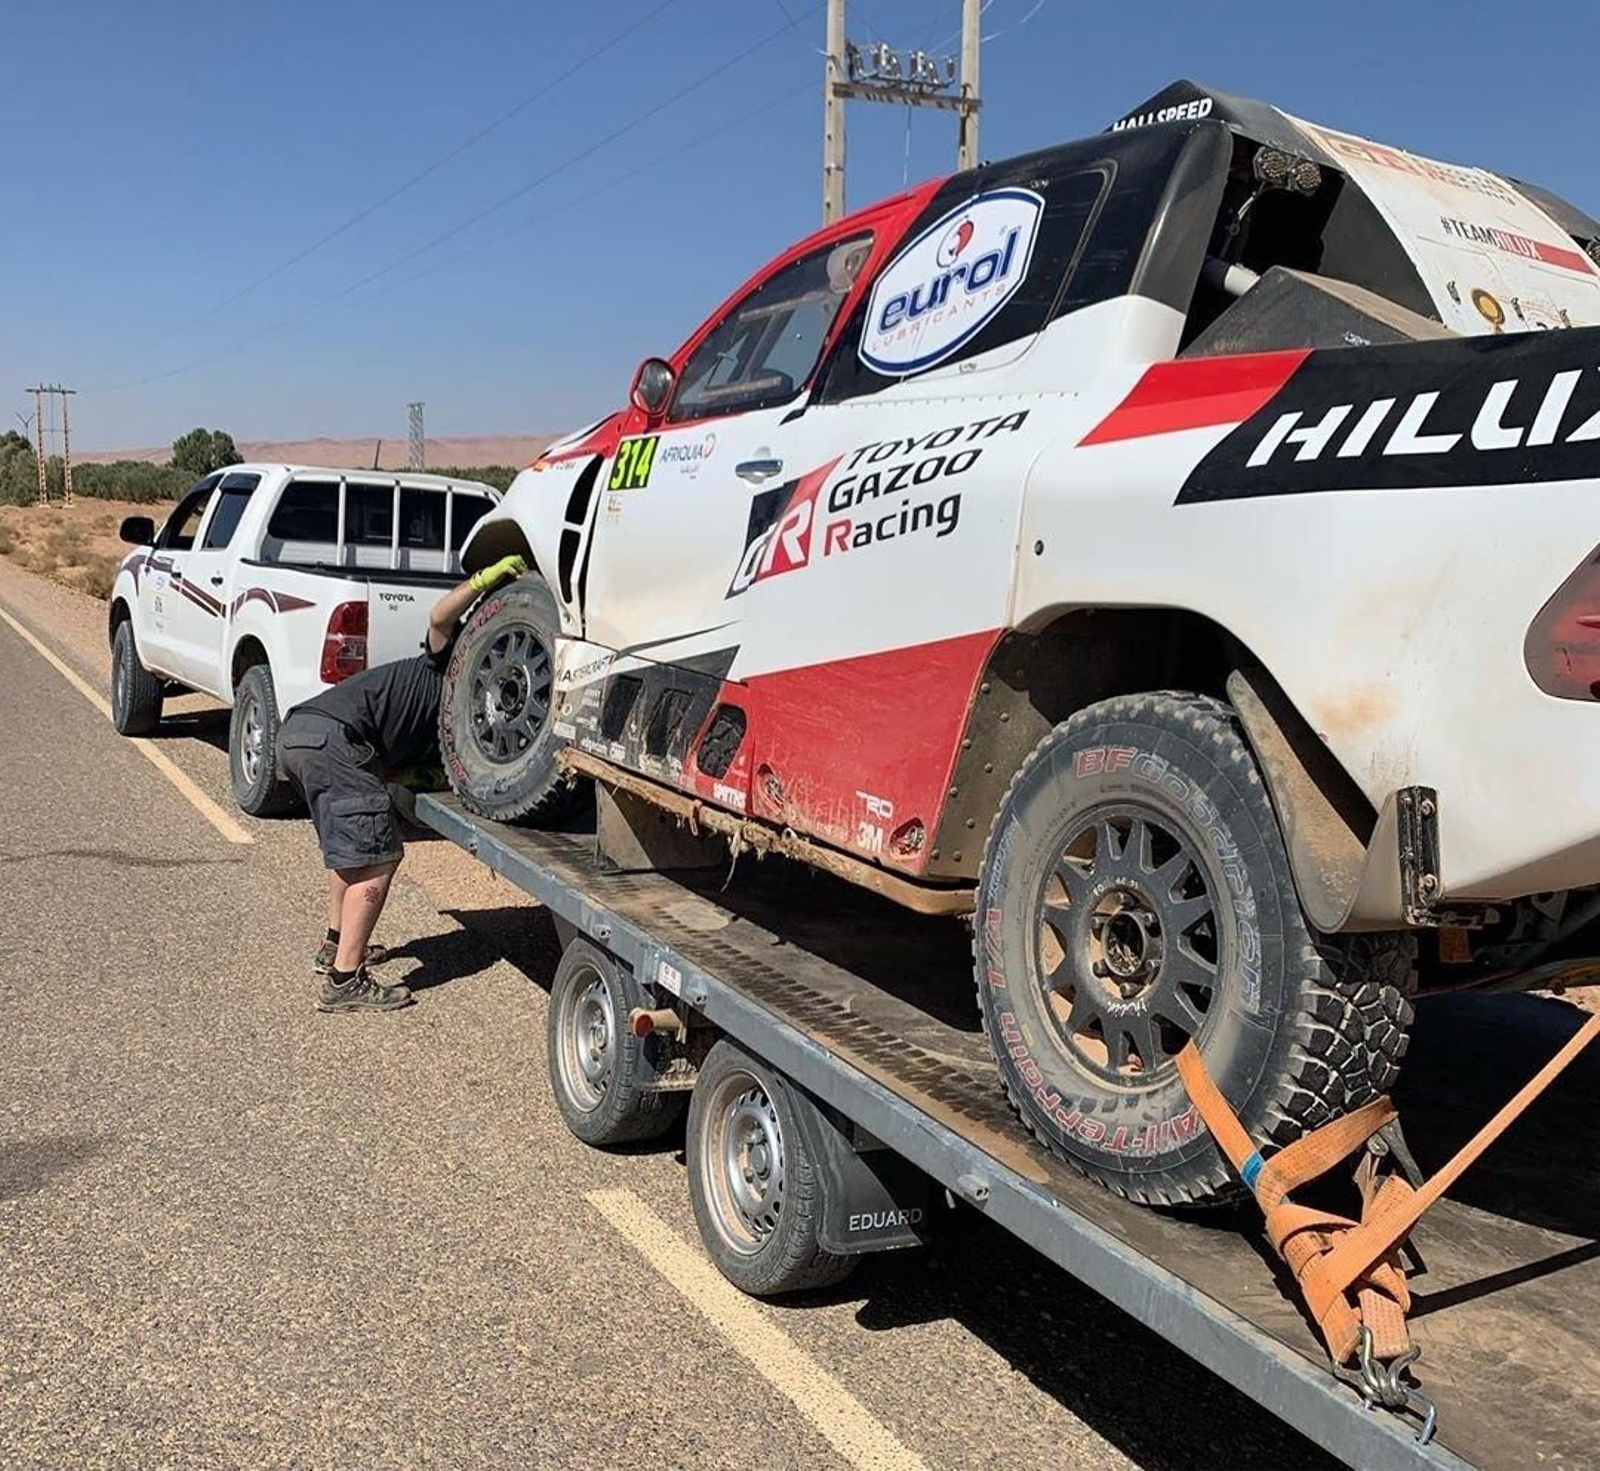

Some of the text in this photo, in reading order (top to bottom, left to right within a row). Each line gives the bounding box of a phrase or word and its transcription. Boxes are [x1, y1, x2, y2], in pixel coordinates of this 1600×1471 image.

[1440, 216, 1543, 261] #TEAMHILUX
[878, 226, 1021, 334] eurol
[872, 284, 1006, 353] LUBRICANTS
[847, 409, 1031, 471] TOYOTA
[1245, 367, 1600, 468] HILU
[610, 437, 656, 490] 314
[828, 449, 984, 514] GAZOO
[823, 493, 962, 557] Racing
[379, 593, 415, 602] TOYOTA
[856, 790, 894, 819] TRD
[857, 821, 884, 853] 3M
[848, 1208, 923, 1232] EDUARD
